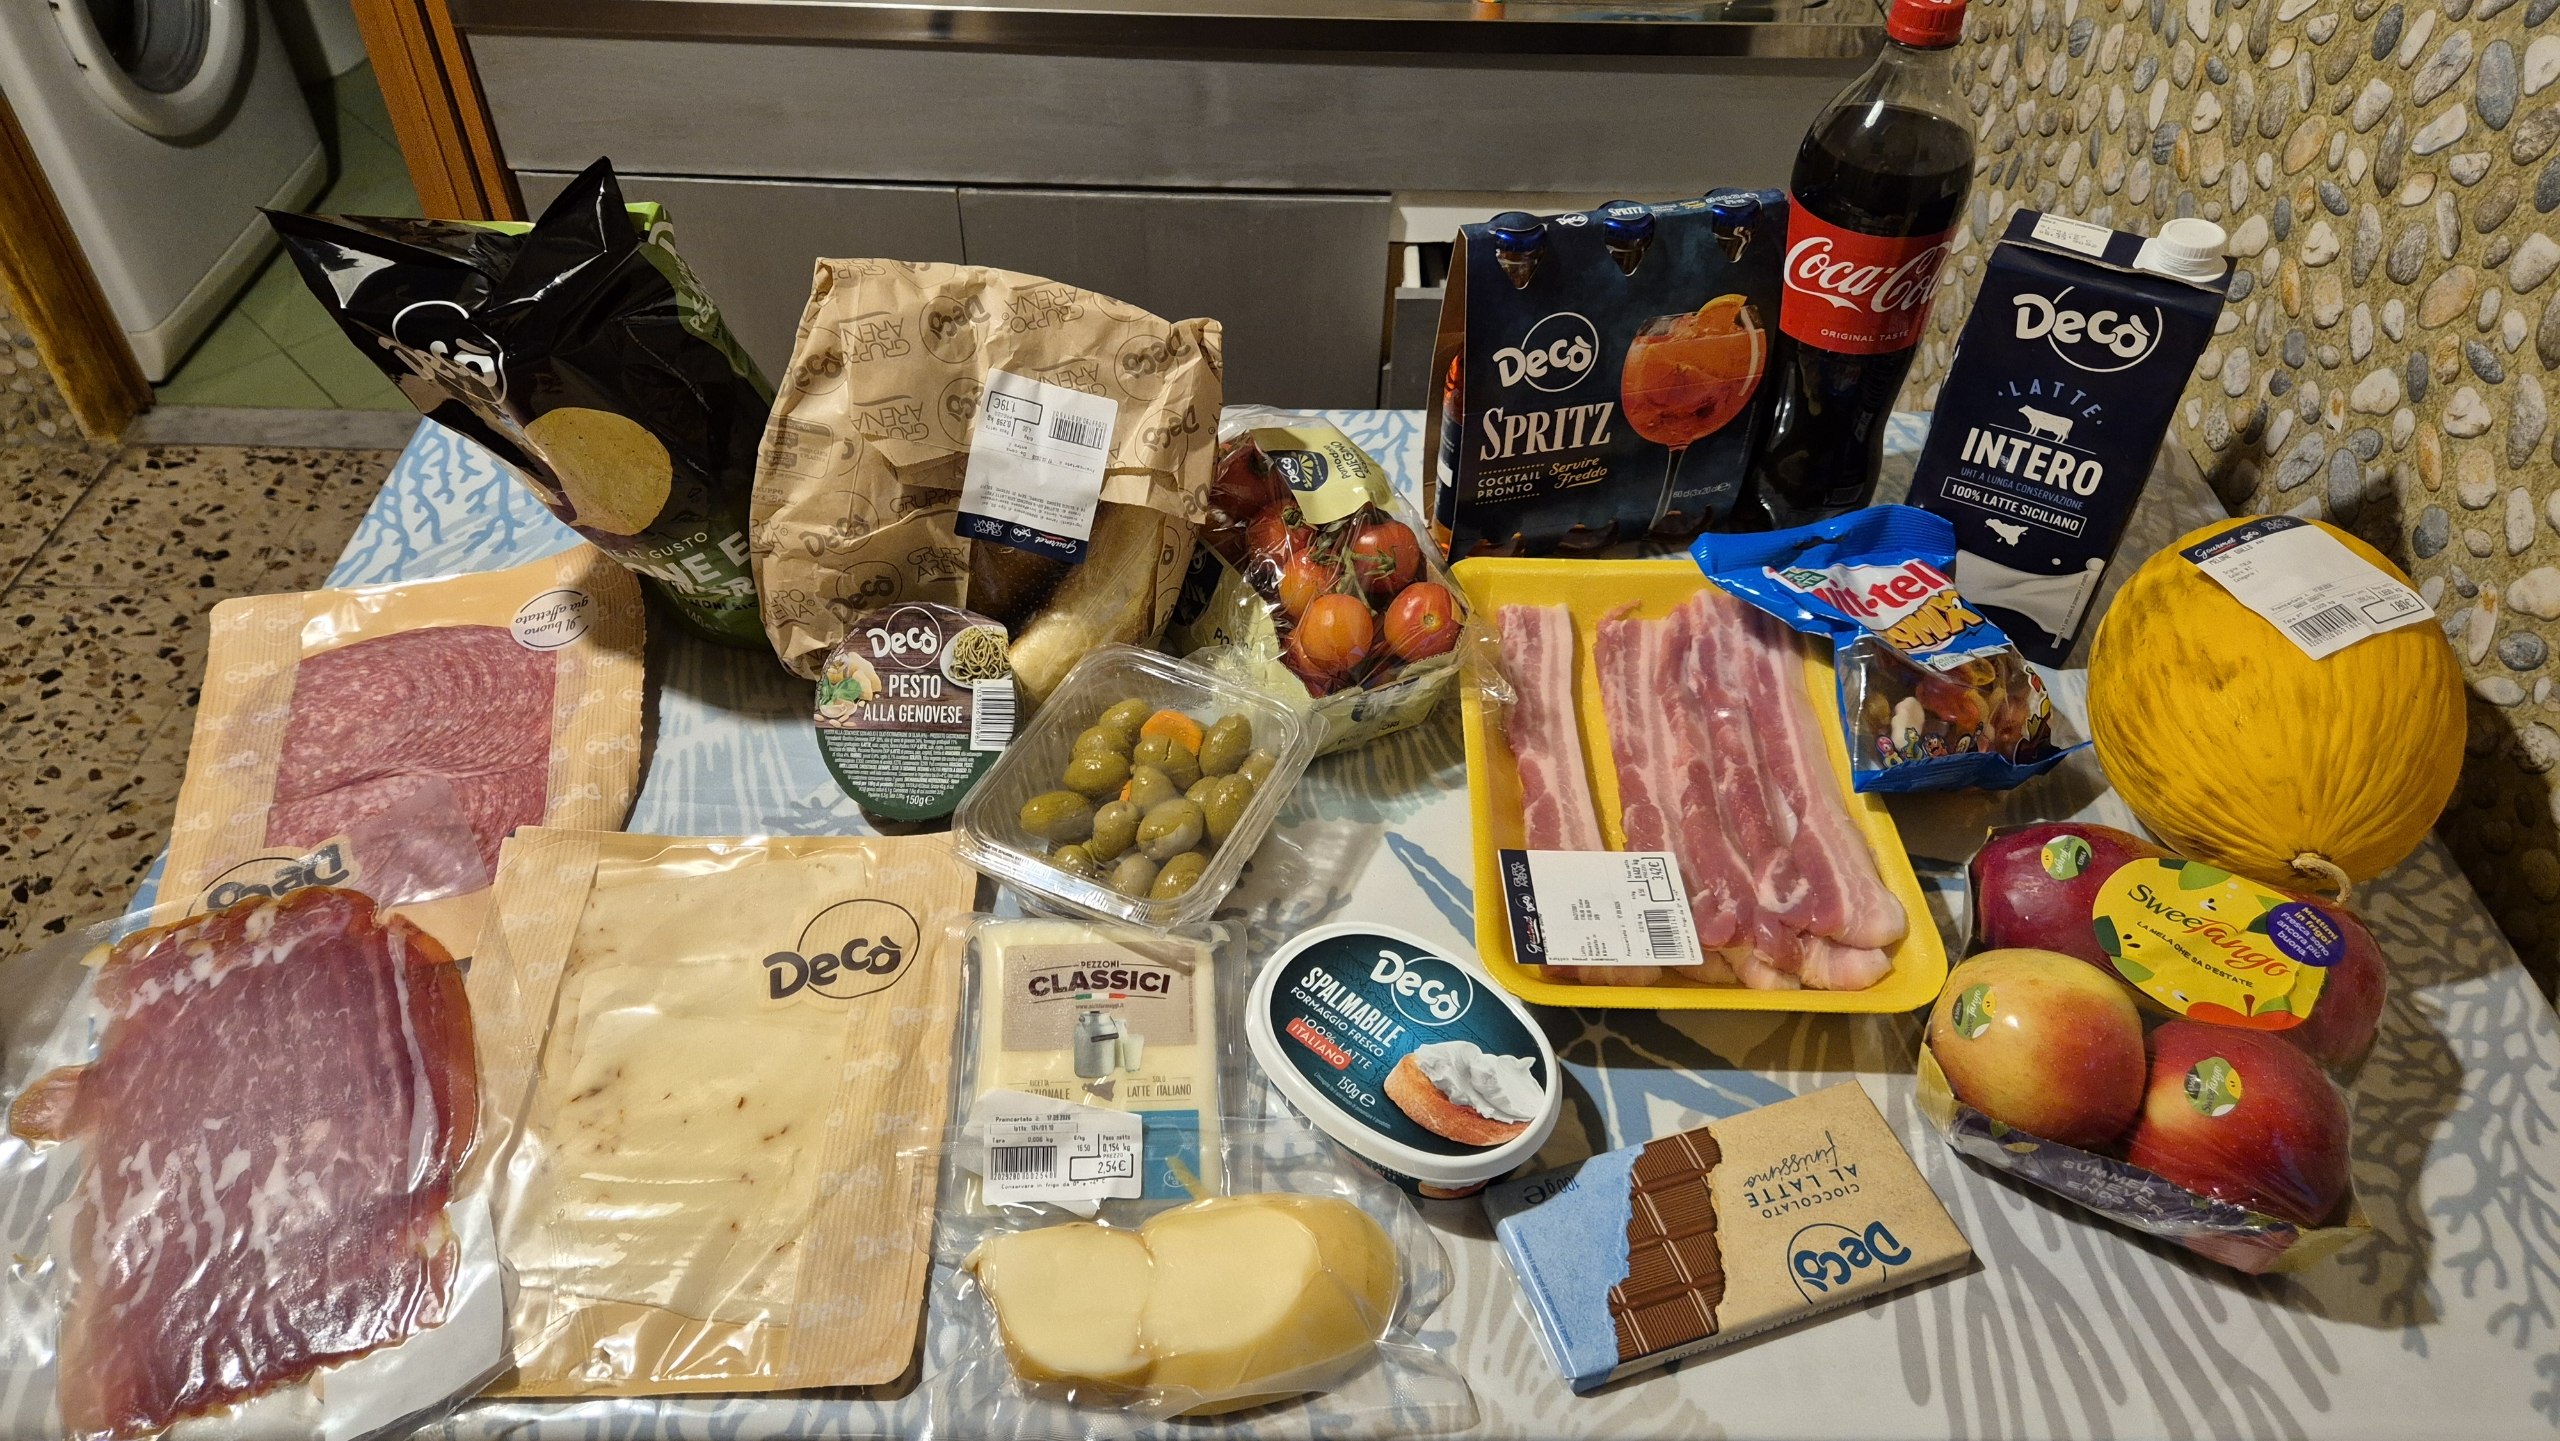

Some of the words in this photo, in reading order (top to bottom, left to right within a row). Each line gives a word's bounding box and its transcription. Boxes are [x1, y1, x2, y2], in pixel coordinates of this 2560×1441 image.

[1608, 206, 1645, 217] SPRITZ
[928, 294, 991, 340] Decò
[1010, 304, 1085, 334] GRUPPO
[2013, 293, 2150, 358] Decò
[1820, 328, 1874, 343] ORIGINAL
[1879, 329, 1910, 341] TASTE
[1122, 327, 1191, 380] Decò
[1493, 335, 1592, 388] Decò
[1479, 401, 1615, 461] SPRITZ
[1549, 456, 1601, 476] Servire
[1554, 465, 1608, 490] Freddo
[1961, 427, 2104, 496] INTERO
[1477, 482, 1533, 499] PRONTO
[1478, 472, 1541, 488] COCKTAIL
[1961, 467, 1977, 477] UHT
[1979, 471, 1985, 480] A
[1987, 473, 2014, 489] LUNGA
[2015, 482, 2083, 511] CONSERVAZIONE
[1952, 484, 1981, 501] 100%
[1983, 493, 2018, 513] LATTE
[2020, 504, 2080, 532] SICILIANO
[649, 532, 708, 559] GUSTO
[1035, 536, 1077, 554] Gourmet
[2194, 536, 2237, 560] Gourmet
[514, 604, 569, 624] affettato
[570, 595, 589, 613] già
[524, 620, 563, 635] buono
[866, 625, 938, 658] Decò
[888, 674, 941, 699] PESTO
[863, 703, 895, 723] ALLA
[898, 704, 963, 724] GENOVESE
[2127, 884, 2291, 976] SweeTango
[2276, 920, 2308, 945] ancora
[2306, 944, 2322, 959] più
[2280, 911, 2310, 936] Fresca
[2309, 935, 2329, 956] sono
[2294, 911, 2306, 921] in
[2305, 920, 2332, 945] frigo!
[2301, 907, 2339, 940] Mettimi
[2137, 920, 2149, 931] LA
[2149, 927, 2174, 946] MELA
[2174, 943, 2192, 959] CHE
[2191, 956, 2204, 967] SA
[2204, 963, 2254, 988] D'ESTATE
[2277, 930, 2307, 957] buona
[763, 935, 902, 1000] Decò
[1080, 960, 1120, 969] PEZZONI
[1028, 969, 1171, 997] CLASSICI
[1370, 950, 1460, 1020] Decò
[1290, 986, 1349, 1031] FORMAGGIO
[1347, 1028, 1384, 1057] FRESCO
[1301, 967, 1405, 1048] SPALMABILE
[1291, 1024, 1345, 1065] ITALIANO
[1301, 1014, 1335, 1045] 100%
[1338, 1042, 1373, 1070] LATTE
[1127, 1086, 1150, 1097] LATTE
[1156, 1084, 1192, 1096] ITALIANO
[1336, 1076, 1361, 1099] 150g
[1098, 1159, 1127, 1174] 2,54€
[1744, 1130, 1837, 1188] finissimo
[1829, 1164, 1857, 1182] AL
[1558, 1175, 1581, 1193] 100
[1744, 1174, 1821, 1208] LATTE
[2062, 1160, 2156, 1198] SUMMER
[1762, 1183, 1860, 1219] CIOCCOLATO
[1794, 1220, 1912, 1292] Decò
